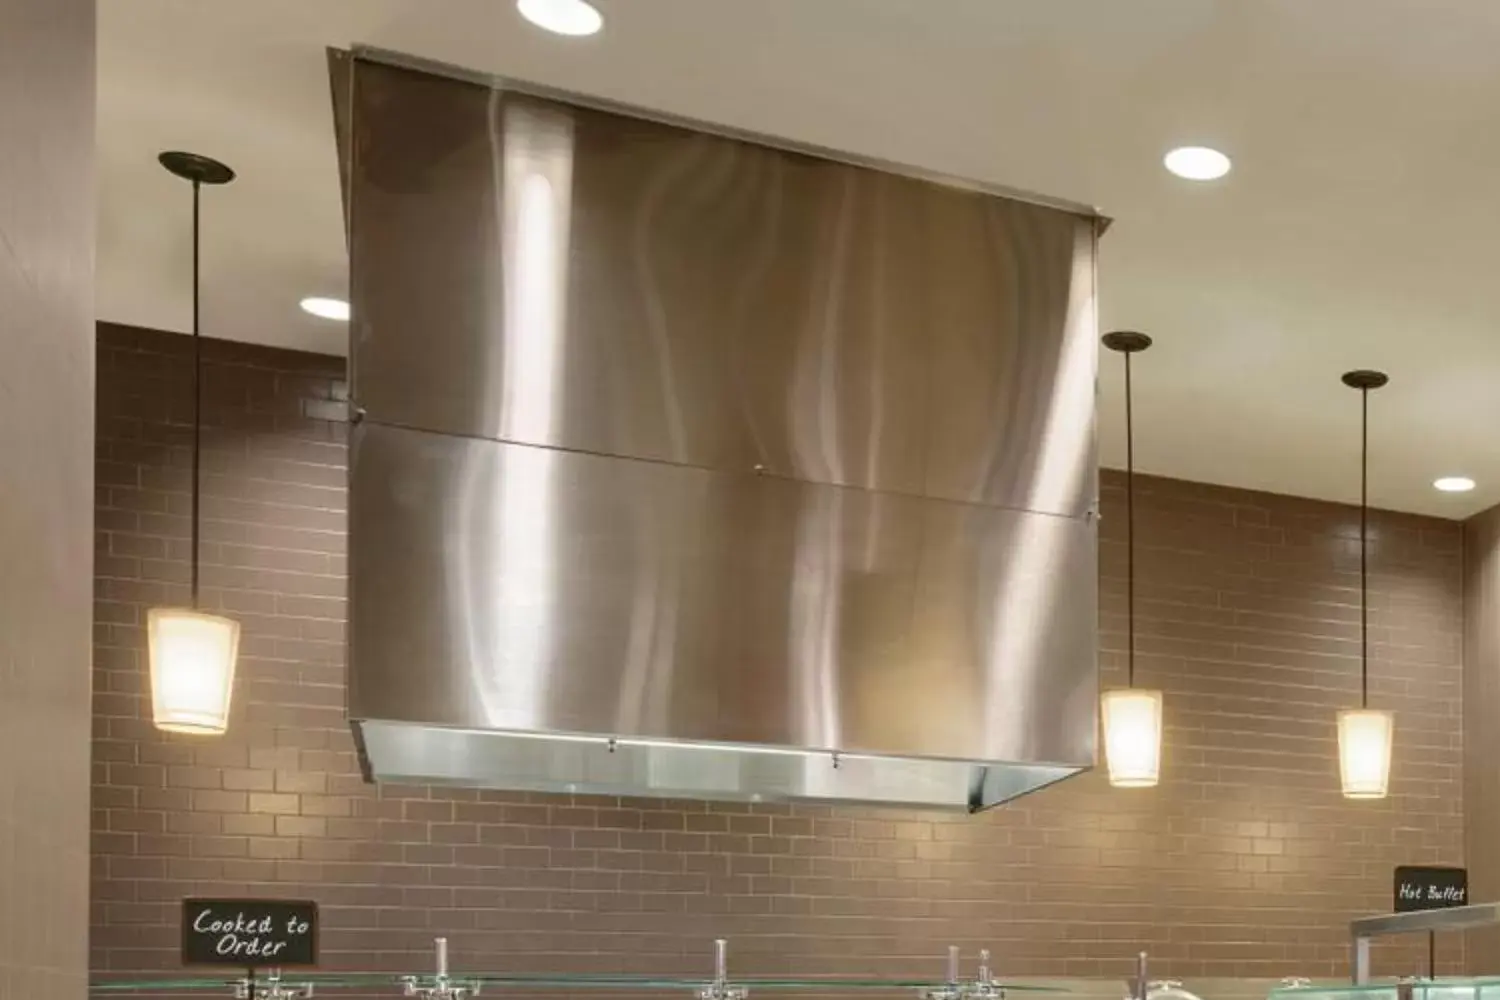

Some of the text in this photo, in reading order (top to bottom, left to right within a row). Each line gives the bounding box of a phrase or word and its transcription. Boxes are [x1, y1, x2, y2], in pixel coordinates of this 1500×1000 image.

[1399, 883, 1465, 901] Hot Buffet
[193, 908, 310, 934] Cooked to
[216, 933, 287, 957] Order
